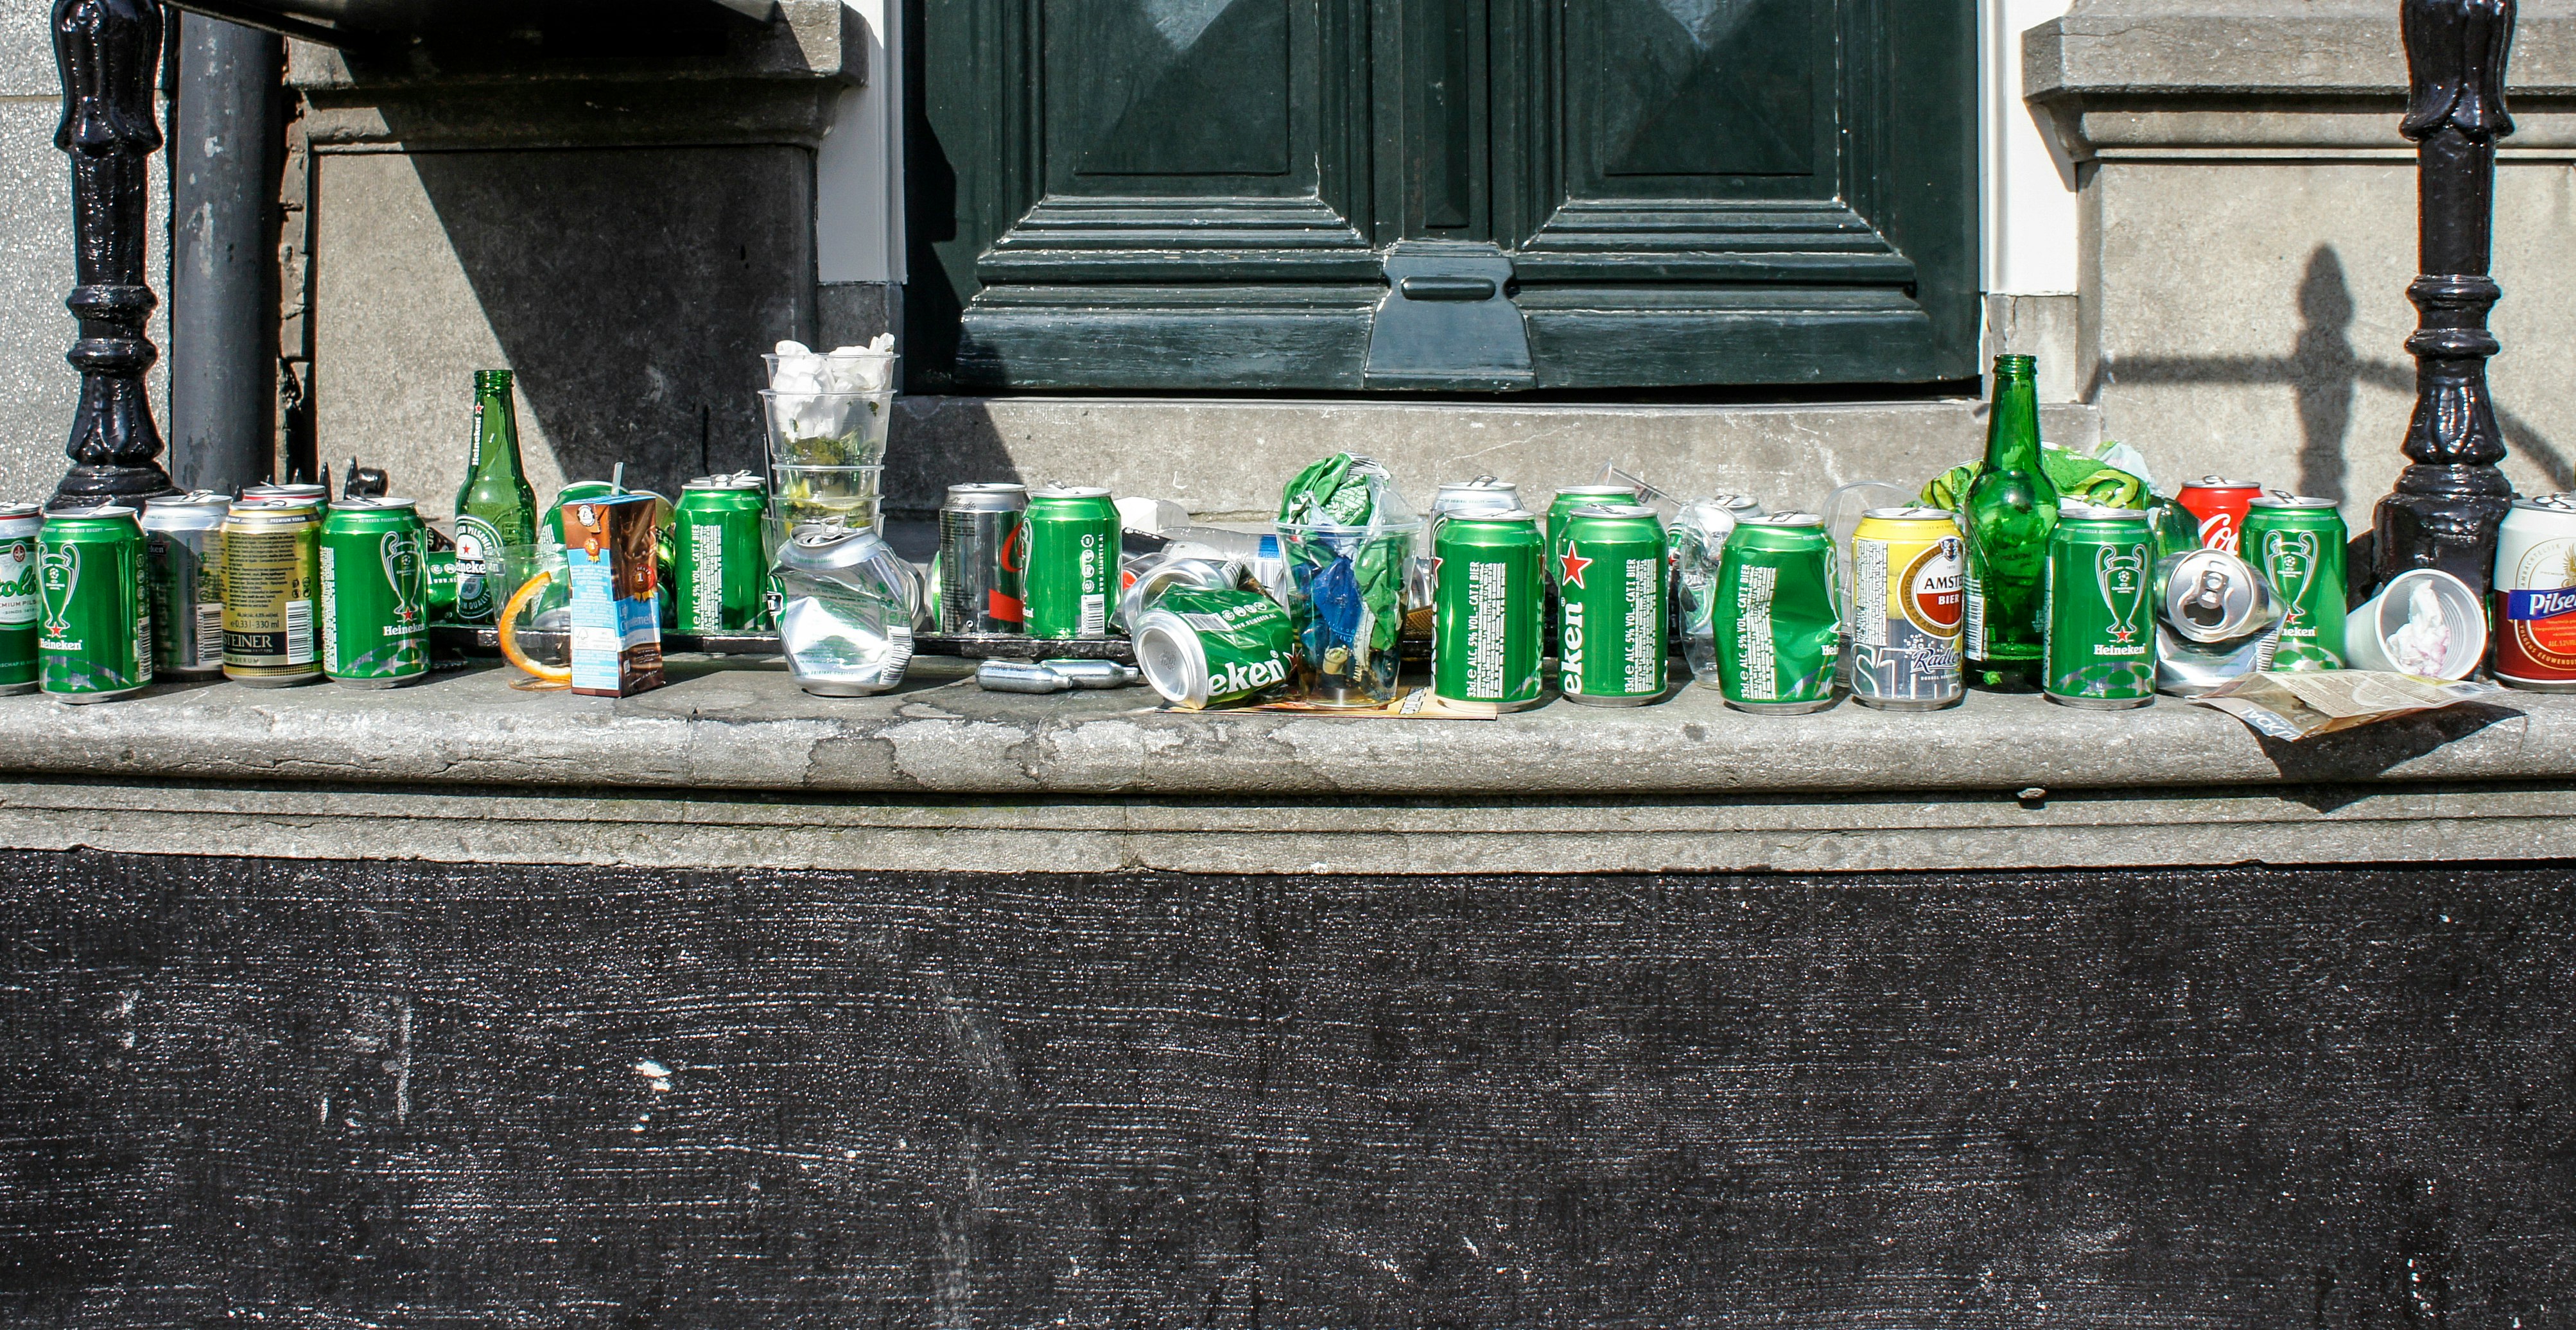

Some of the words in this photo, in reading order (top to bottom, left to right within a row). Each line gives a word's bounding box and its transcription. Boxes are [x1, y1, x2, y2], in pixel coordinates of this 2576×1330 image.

[471, 417, 482, 466] Heineken
[692, 524, 700, 540] BIER
[1469, 561, 1480, 580] BIER
[1626, 558, 1636, 577] BIER
[1739, 564, 1751, 583] BIER
[692, 585, 701, 597] 5%
[0, 600, 21, 609] MIUM
[1938, 594, 1960, 605] BIER
[257, 620, 269, 628] 330
[271, 619, 279, 628] ml
[383, 623, 426, 636] Heineken
[1468, 632, 1478, 647] 5%
[1625, 628, 1635, 643] 5%
[1737, 634, 1747, 649] 5%
[2519, 625, 2537, 653] VOLGENS
[39, 638, 83, 650] Heineken
[1561, 601, 1583, 695] eken
[2093, 643, 2145, 655] Heineken
[1467, 648, 1478, 666] ALC.
[1625, 644, 1635, 662] ALC.
[1738, 650, 1748, 668] ALC.
[1208, 659, 1285, 696] eken
